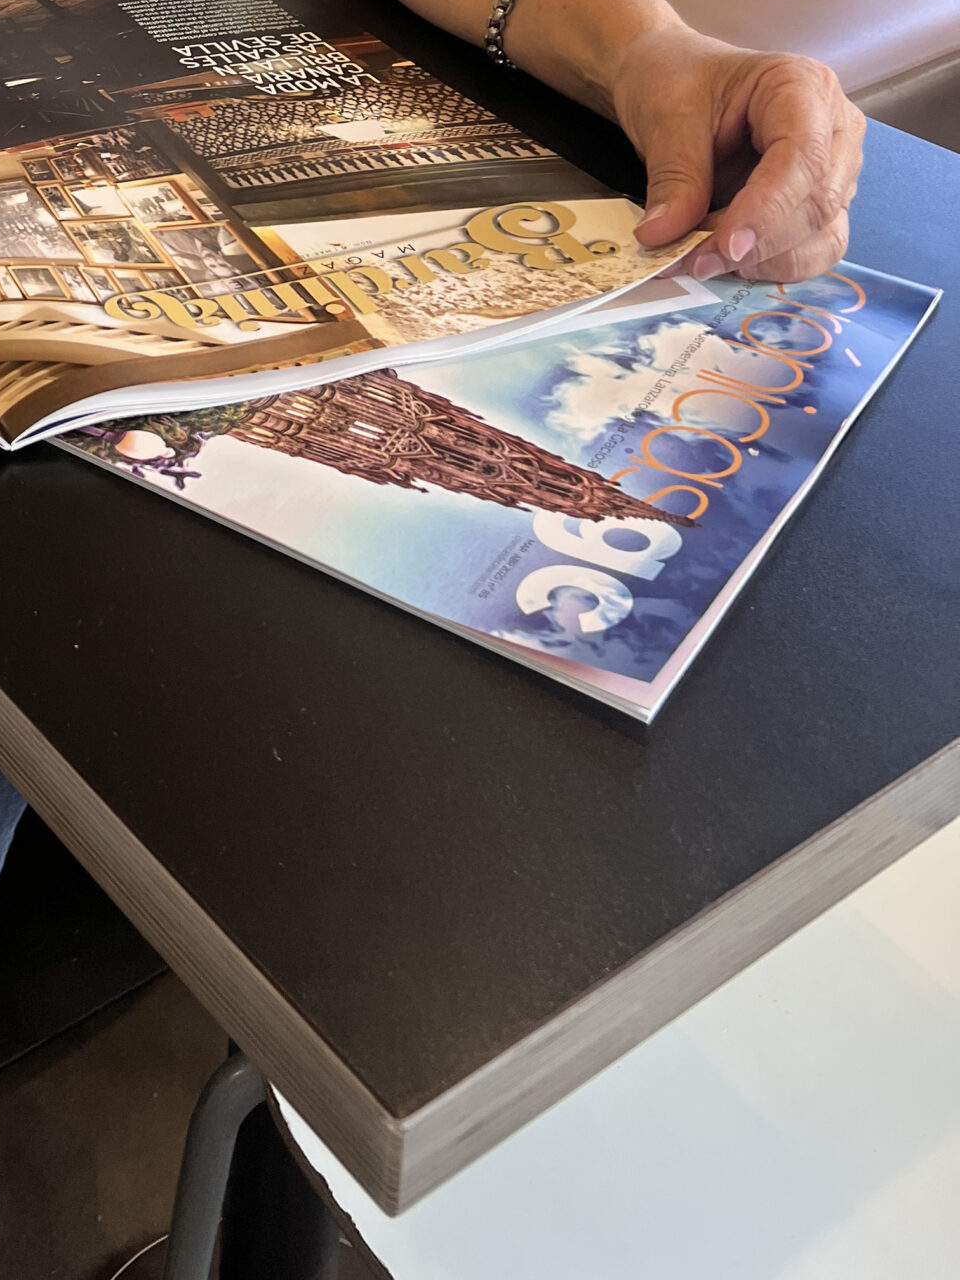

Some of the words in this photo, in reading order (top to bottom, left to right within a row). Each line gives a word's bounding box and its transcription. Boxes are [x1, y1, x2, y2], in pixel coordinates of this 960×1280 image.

[171, 35, 282, 57] SEVILLA
[280, 31, 323, 44] DE
[282, 41, 336, 55] LAS
[179, 47, 278, 69] CALLES
[246, 51, 351, 75] BRILLA
[212, 60, 257, 77] EN
[241, 62, 364, 85] CANARIA
[255, 80, 341, 95] MODA
[338, 73, 381, 87] LA
[104, 201, 622, 332] Bardinia
[617, 422, 632, 437] La
[586, 433, 624, 472] Graciosa
